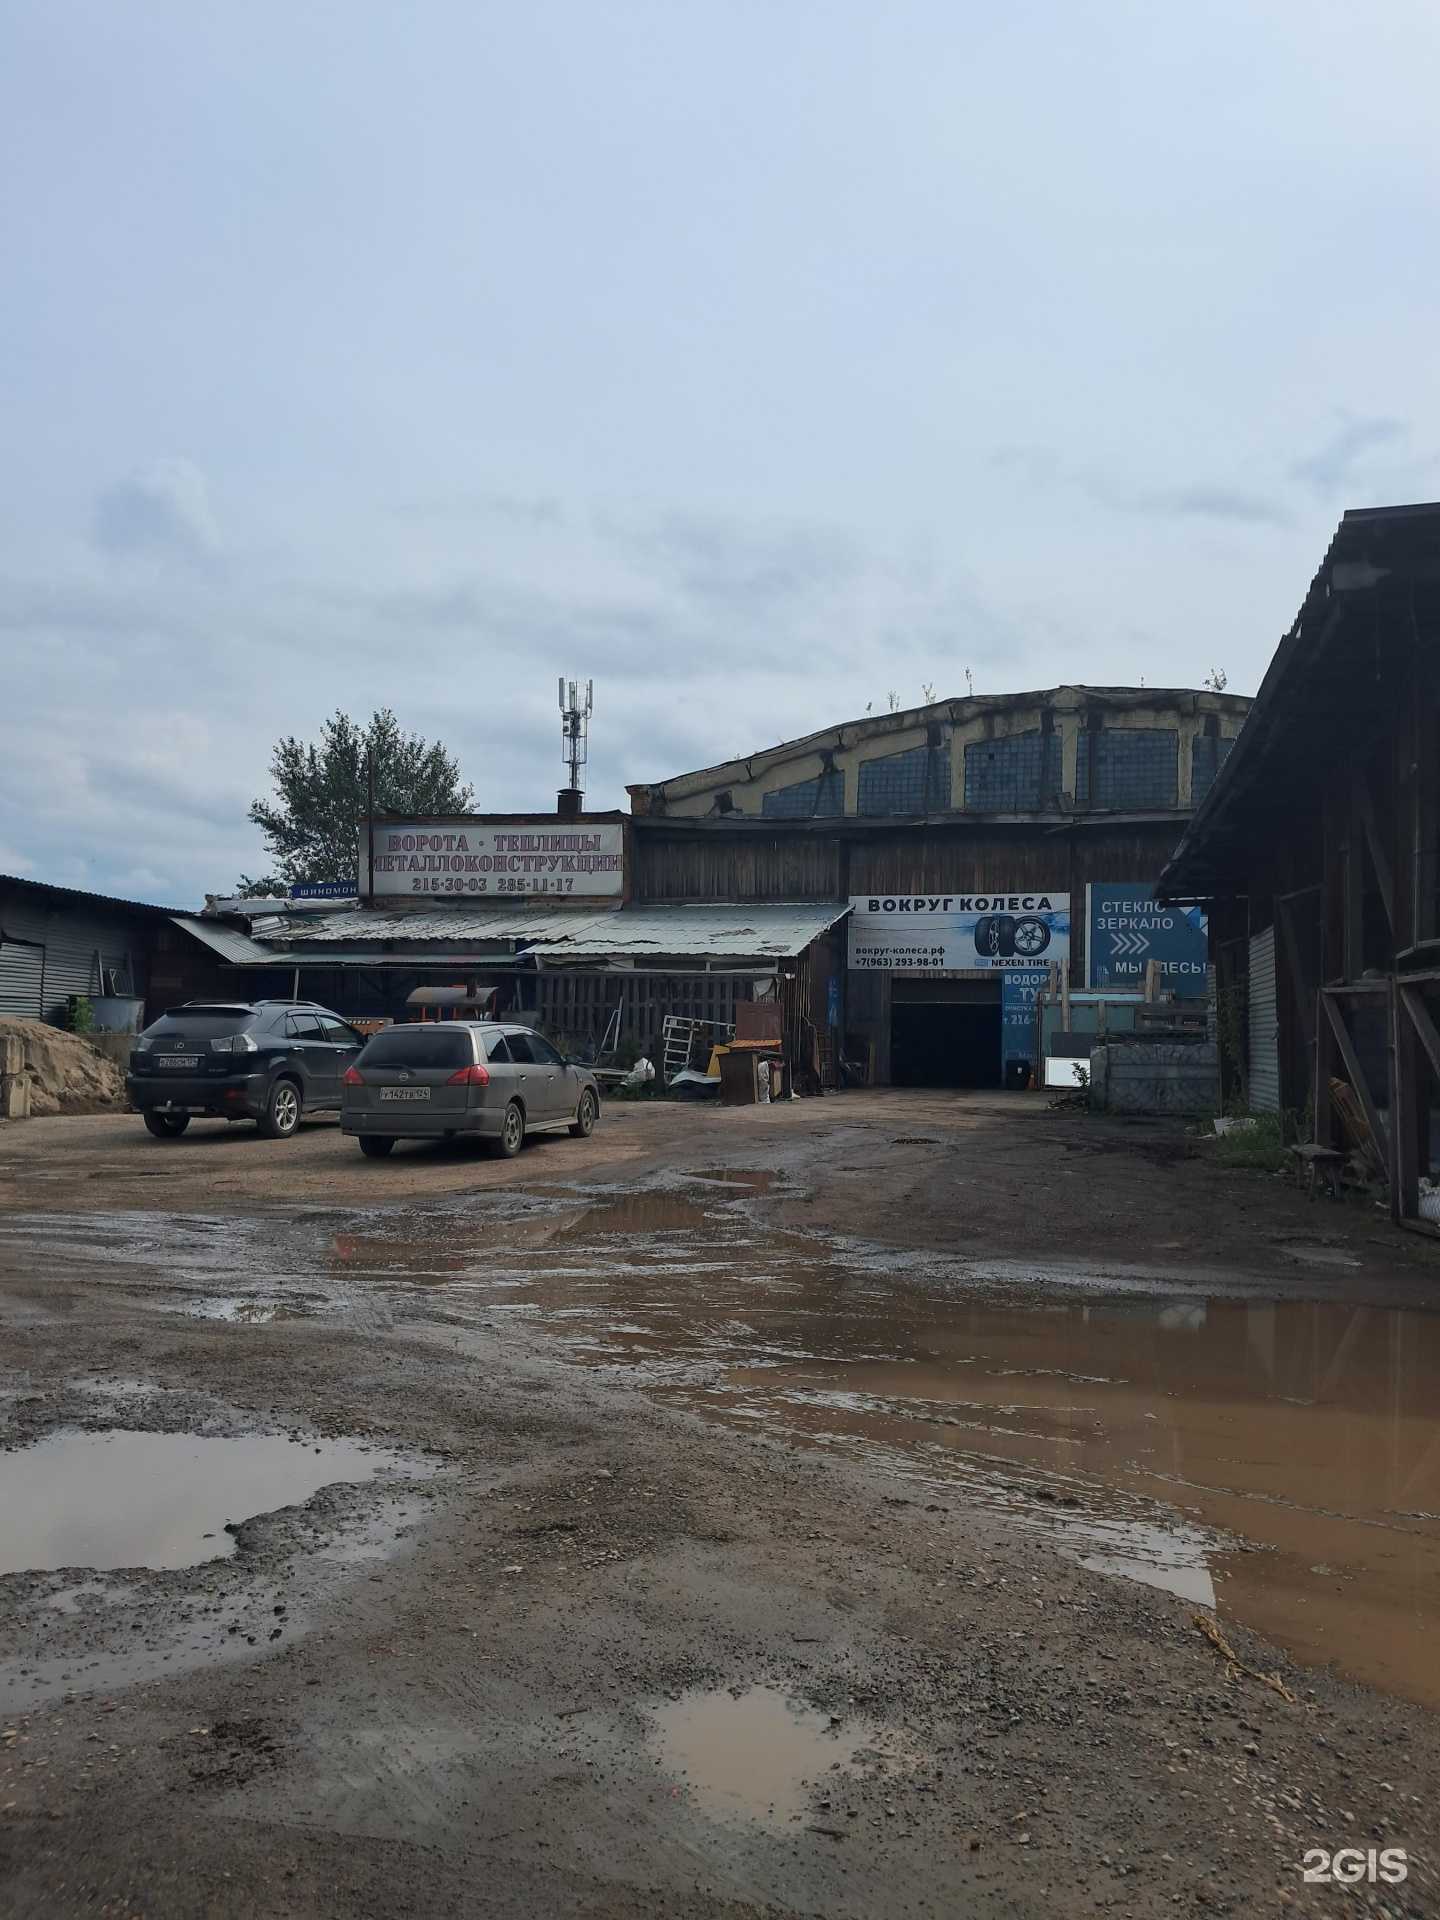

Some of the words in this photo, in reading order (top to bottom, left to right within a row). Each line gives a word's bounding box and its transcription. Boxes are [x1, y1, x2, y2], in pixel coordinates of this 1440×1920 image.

[388, 834, 469, 852] ВОРОТА
[493, 834, 602, 854] ТЕПЛИЦЫ
[868, 898, 953, 912] ВОКРУГ
[960, 897, 1052, 911] КОЛЕСА
[1097, 917, 1174, 930] ЗЕРКАЛО
[855, 945, 945, 956] вокруг-колеса.рф
[856, 957, 892, 968] +7(963)
[895, 957, 944, 967] 293-98-01
[991, 958, 1024, 967] NEXEN
[1028, 958, 1050, 967] TIRE
[1115, 962, 1142, 974] МЫ
[1148, 962, 1207, 976] ДЕСЬ!
